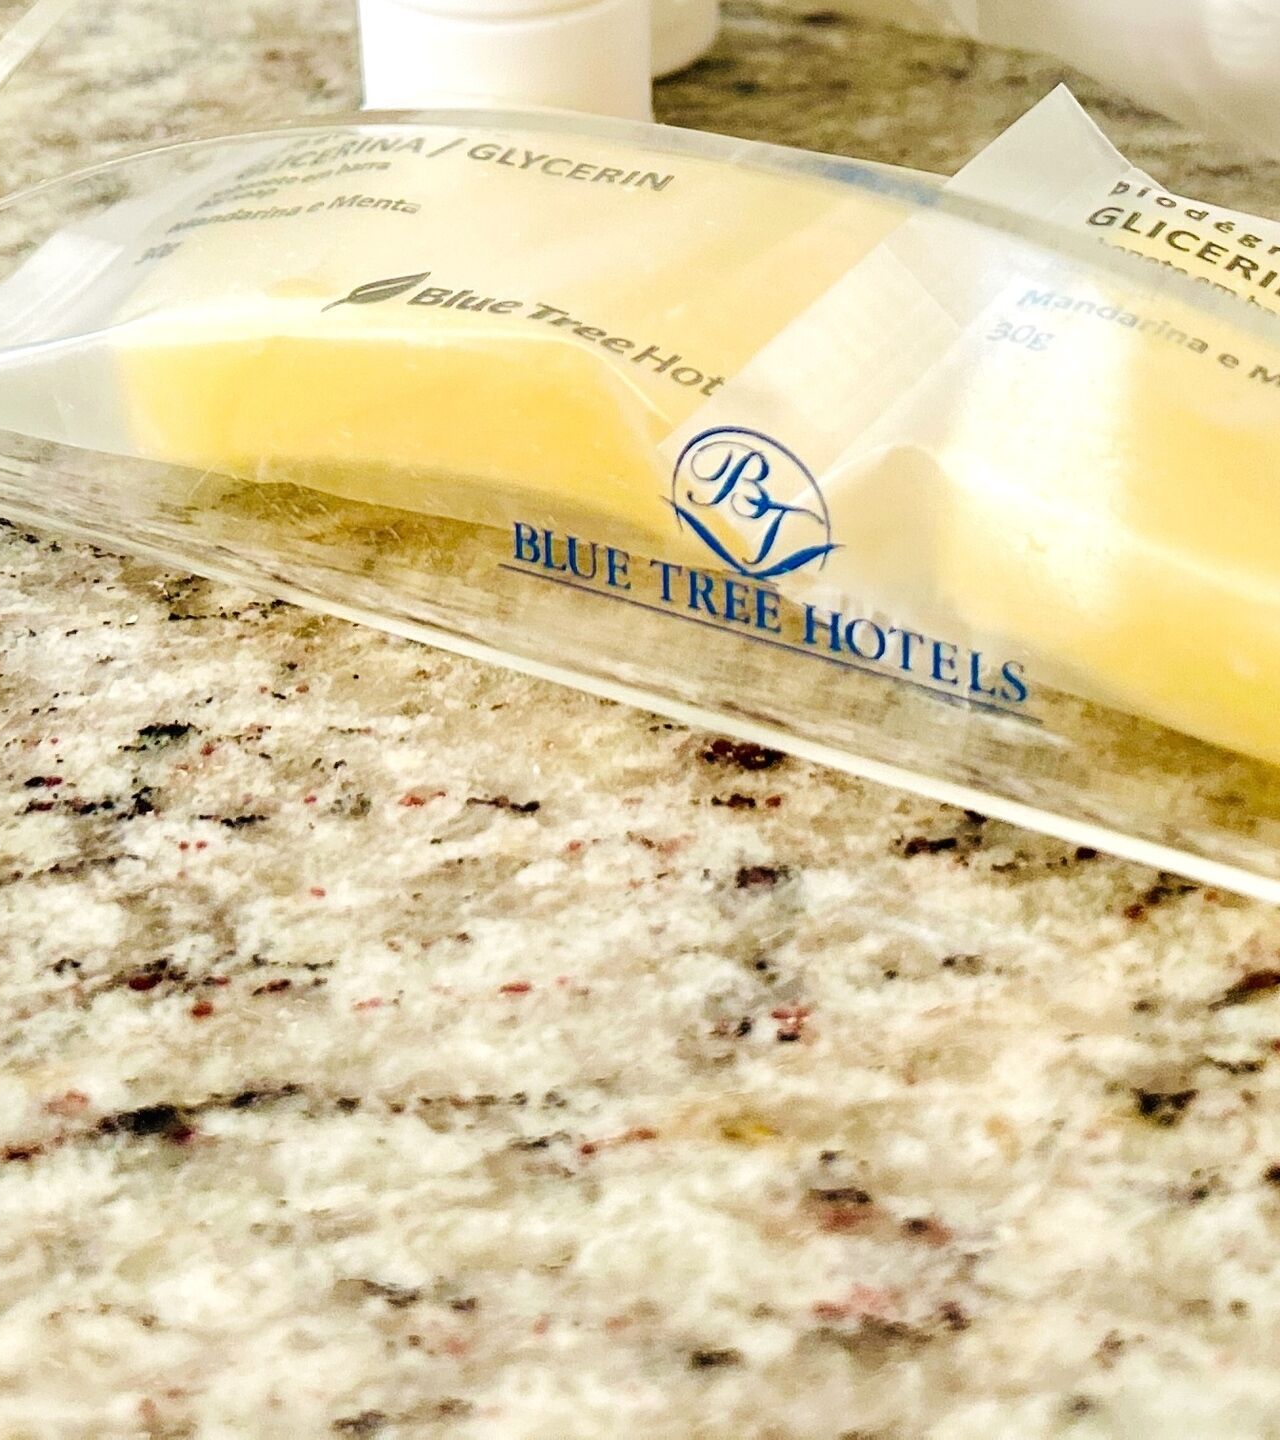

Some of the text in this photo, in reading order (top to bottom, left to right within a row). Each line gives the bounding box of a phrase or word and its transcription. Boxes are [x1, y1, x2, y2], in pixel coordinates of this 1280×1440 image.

[464, 142, 676, 194] GLYCERIN
[327, 194, 422, 215] Menta
[407, 286, 524, 315] Blue
[527, 301, 636, 356] Tree
[1016, 288, 1210, 355] Mandarina
[1217, 352, 1241, 370] e
[512, 520, 1030, 703] BLUE TREE HOTELS
